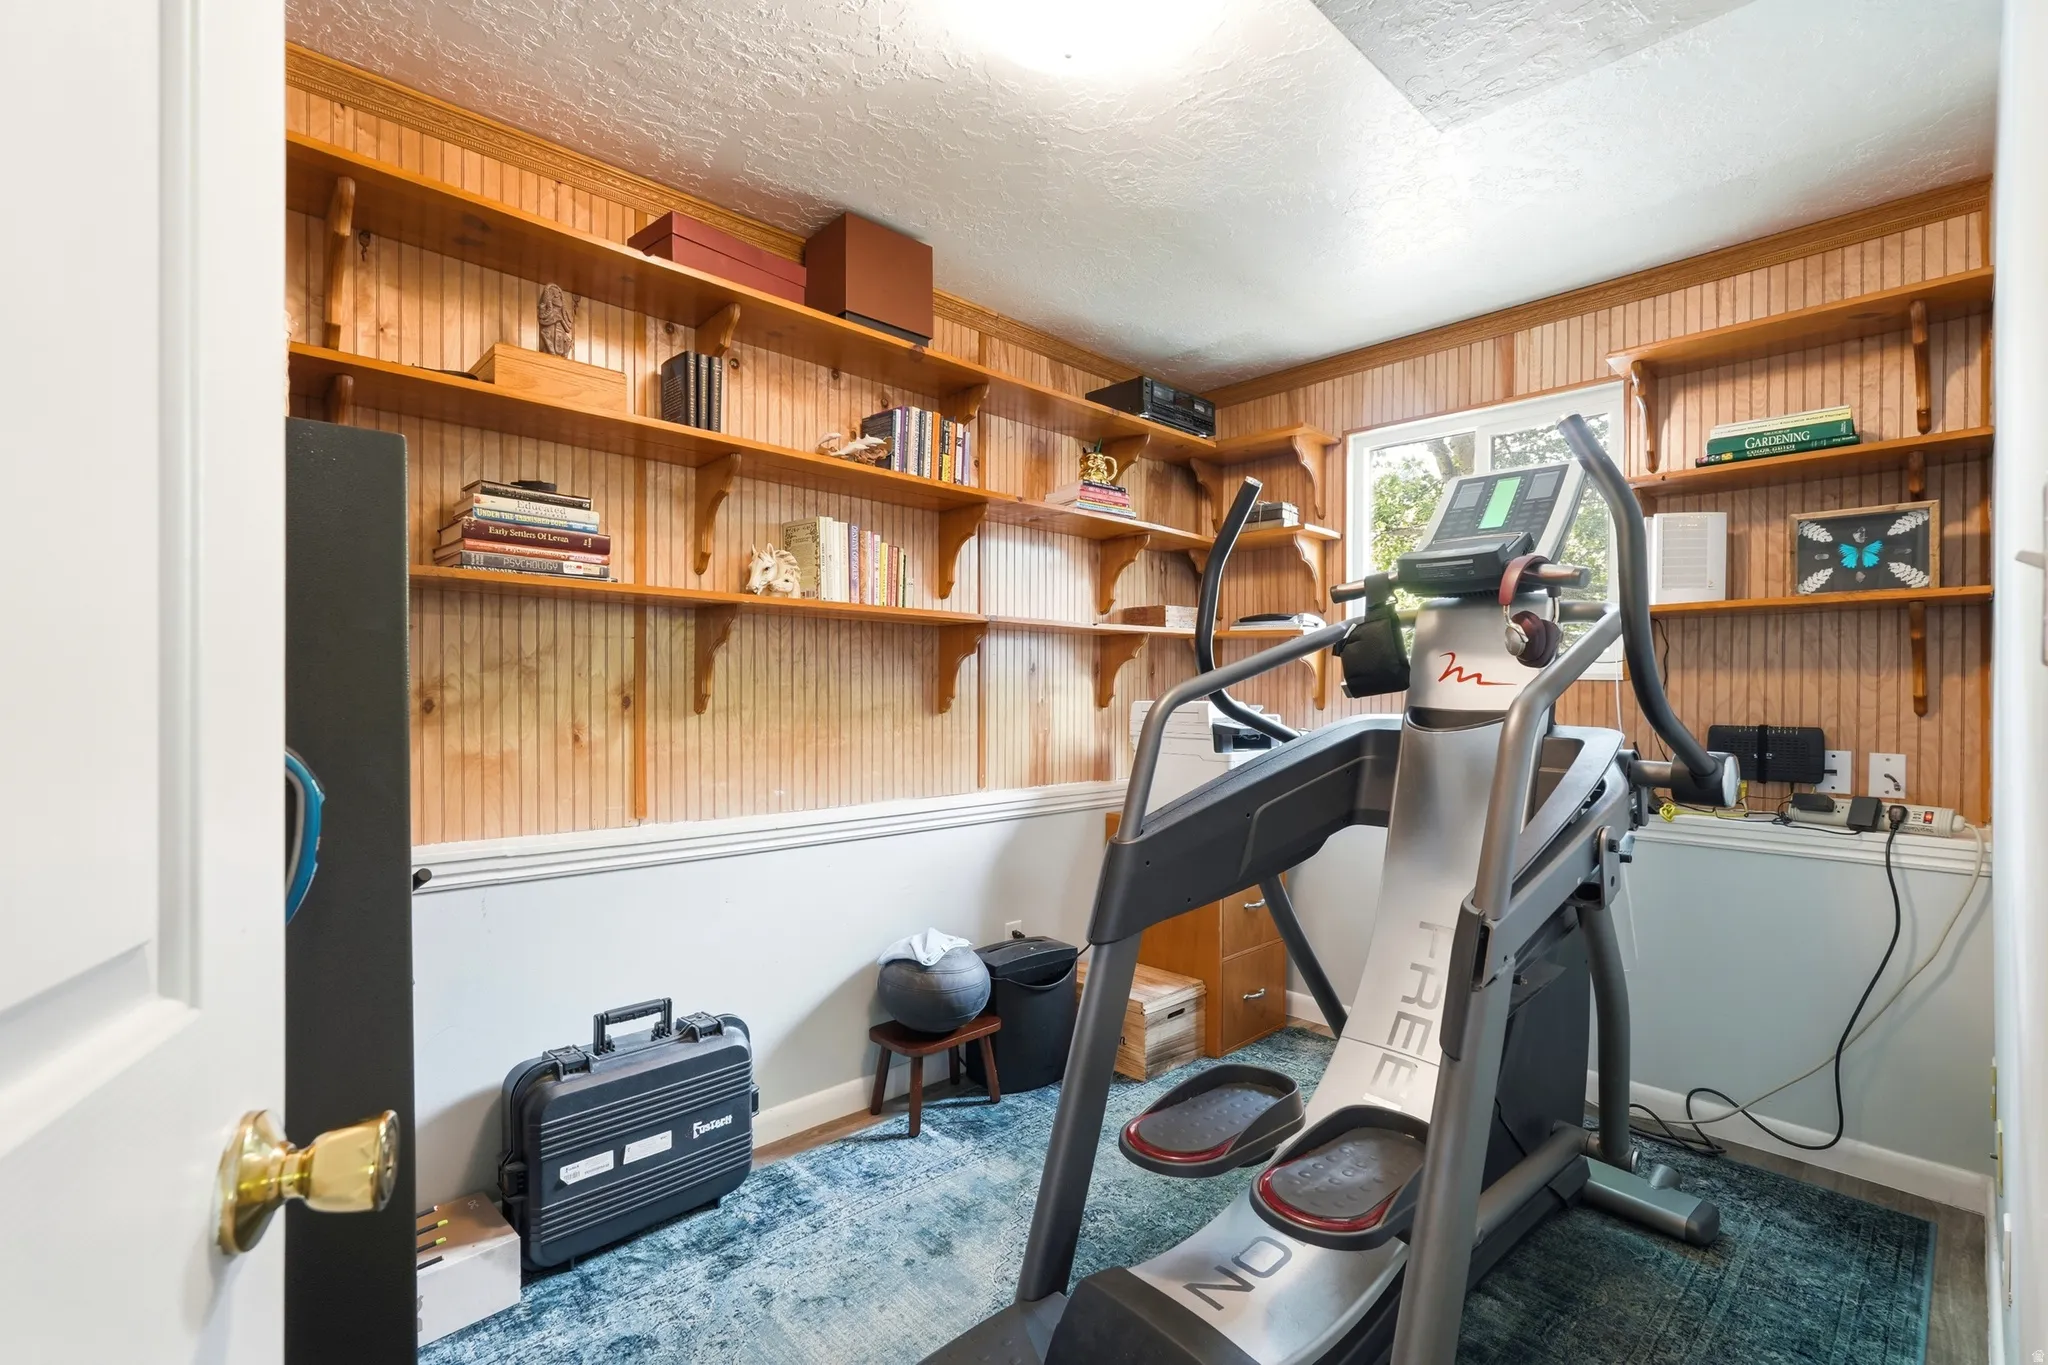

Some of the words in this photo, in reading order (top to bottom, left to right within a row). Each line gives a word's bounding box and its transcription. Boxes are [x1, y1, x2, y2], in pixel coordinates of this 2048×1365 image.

[1745, 430, 1810, 449] GARDENING
[477, 508, 500, 519] UNDER
[517, 500, 566, 515] Educated
[488, 525, 509, 537] Early
[509, 528, 536, 539] Settlers
[537, 532, 547, 540] Of
[548, 533, 569, 543] Levan
[503, 557, 558, 571] PSYCHOLOGY
